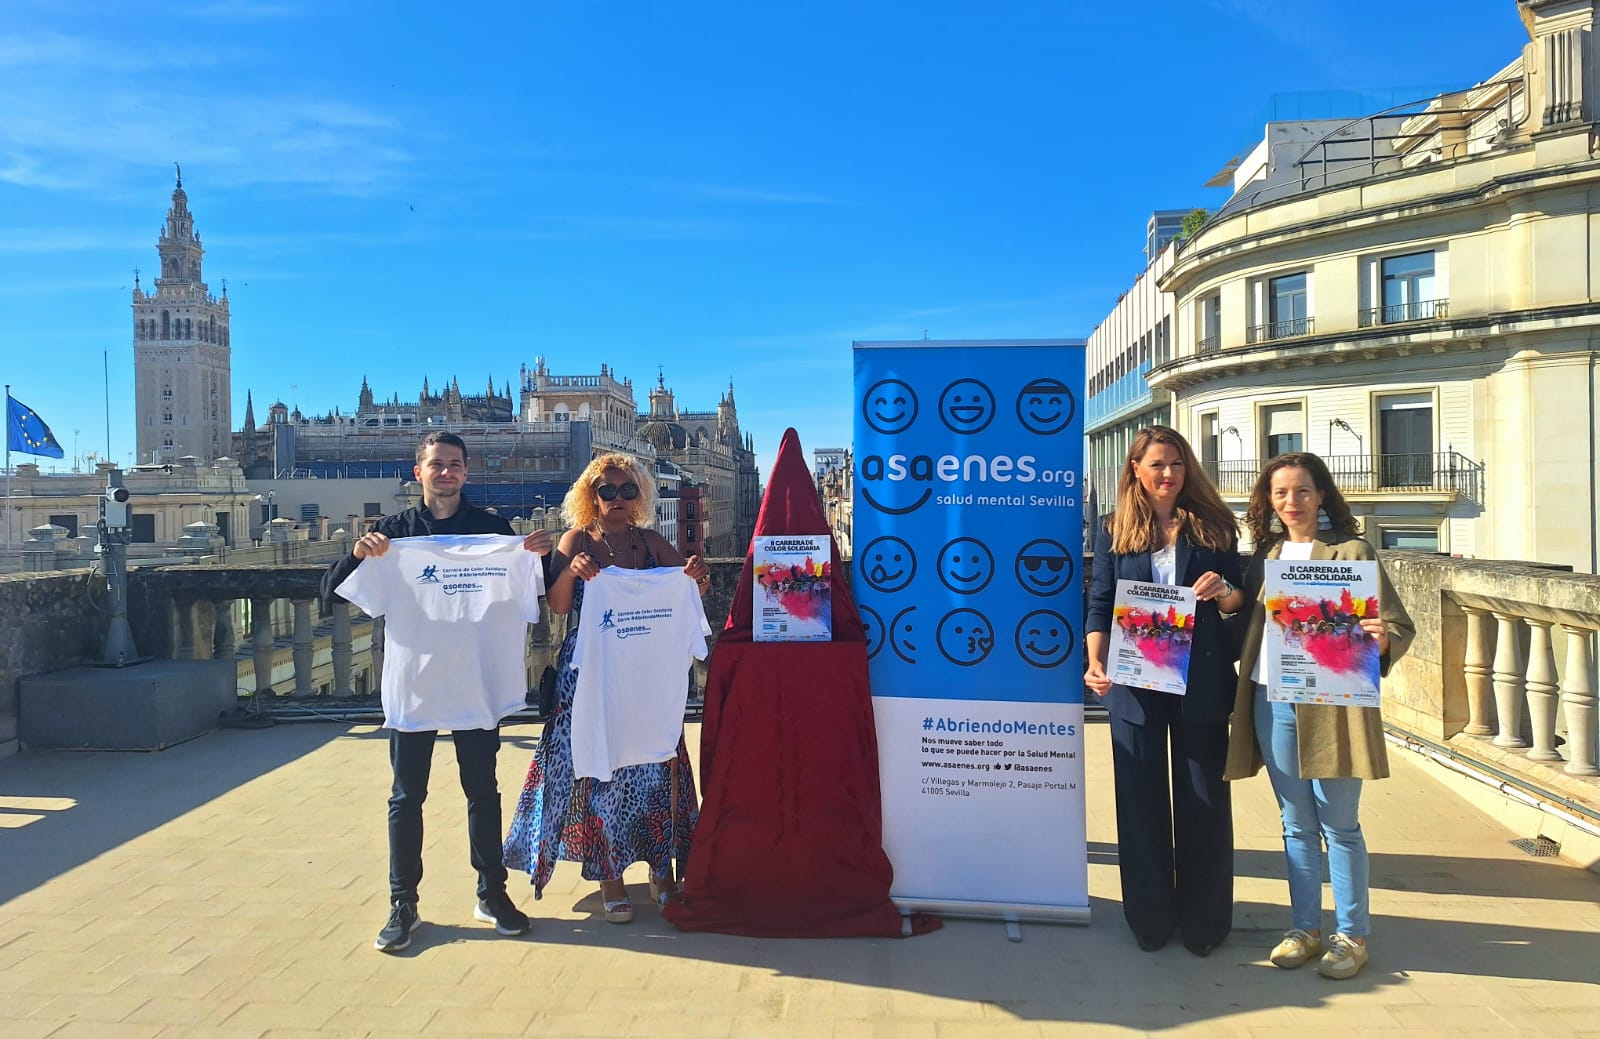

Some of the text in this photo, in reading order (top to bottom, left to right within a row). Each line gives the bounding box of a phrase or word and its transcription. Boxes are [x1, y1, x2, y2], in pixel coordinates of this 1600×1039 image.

[861, 454, 1075, 487] asaenes.org
[936, 494, 1075, 507] salud mental Sevilla
[1139, 586, 1169, 594] CARRERA
[1151, 592, 1185, 601] SOLIDARIA
[922, 717, 1075, 736] #AbriendoMentes
[964, 738, 984, 746] saber
[987, 739, 1003, 747] todo
[957, 747, 978, 756] puede
[981, 748, 1001, 756] hacer
[1004, 750, 1015, 758] por
[1018, 749, 1025, 757] la
[1027, 750, 1047, 758] Salud
[1050, 751, 1075, 759] Mental
[922, 761, 1053, 772] www.asaenes.org @asaenes
[931, 777, 959, 786] Villegas
[968, 779, 1006, 789] Marmolejo
[1018, 781, 1042, 790] Pasaje
[1045, 782, 1067, 790] Portal
[922, 787, 970, 797] 41005 Sevilla
